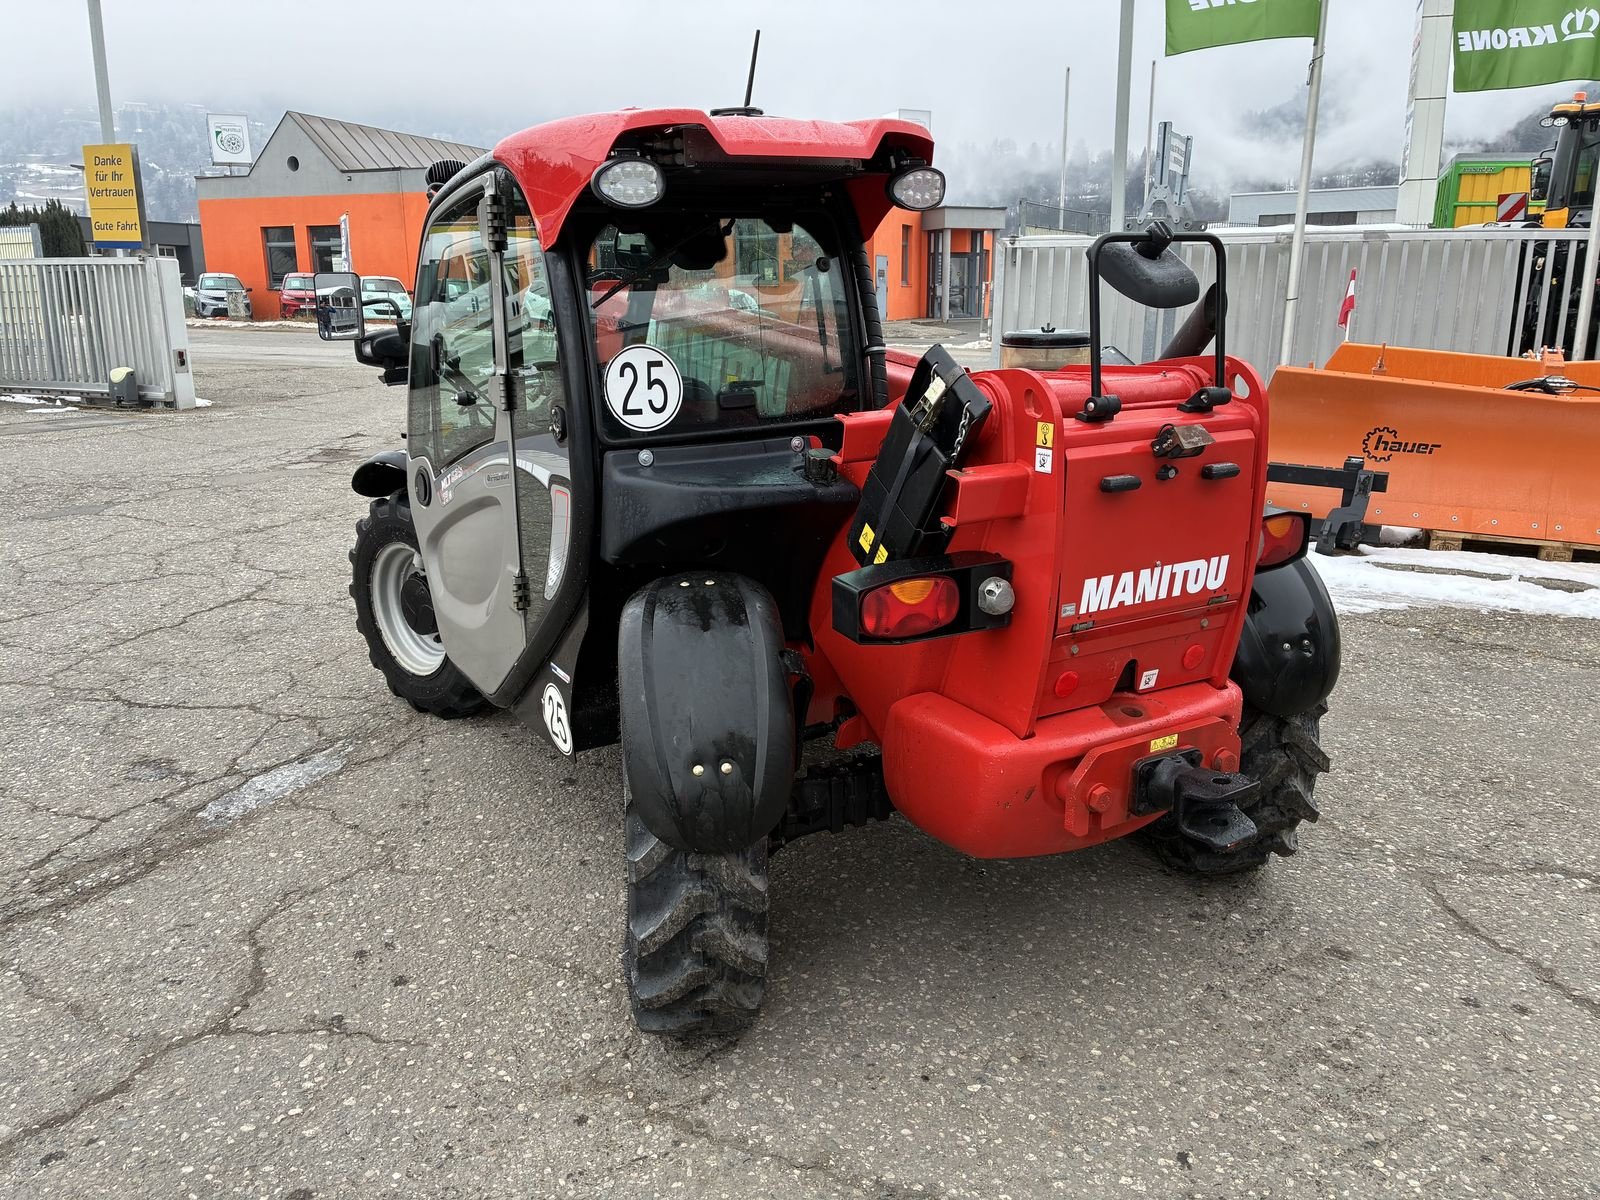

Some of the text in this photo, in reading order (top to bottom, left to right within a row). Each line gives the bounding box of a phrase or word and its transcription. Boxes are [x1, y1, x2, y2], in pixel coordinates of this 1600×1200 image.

[94, 155, 122, 166] Danke
[95, 171, 123, 182] für Ihr
[90, 187, 134, 198] Vertrauen
[94, 221, 138, 231] Gute Fahrt
[619, 360, 668, 416] 25
[1374, 435, 1442, 455] hauer
[1078, 554, 1230, 615] MANITOU
[548, 695, 567, 745] 25
